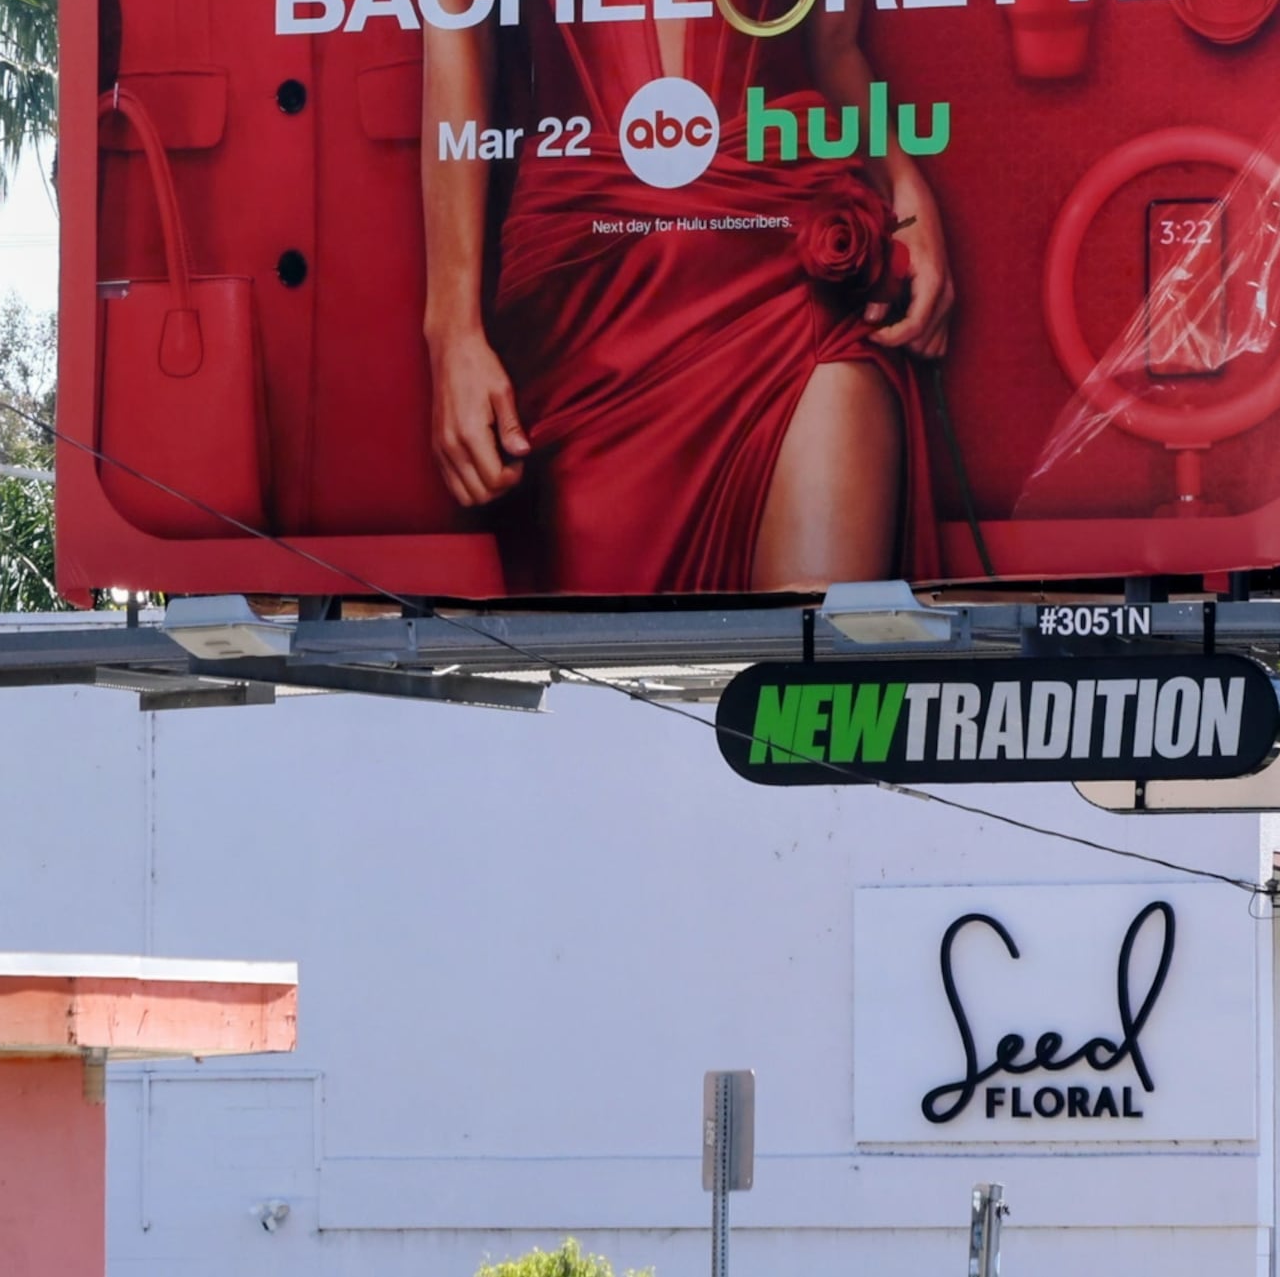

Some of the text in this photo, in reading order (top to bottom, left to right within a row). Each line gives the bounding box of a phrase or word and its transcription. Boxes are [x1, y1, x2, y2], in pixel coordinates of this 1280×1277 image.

[437, 82, 951, 162] Mar 22 abc hulu
[592, 214, 793, 235] Next day for Hulu subscribers.
[1160, 220, 1213, 245] 3:22
[1039, 606, 1151, 637] #3051N
[921, 900, 1176, 1124] Seed
[984, 1086, 1144, 1119] FLORAL
